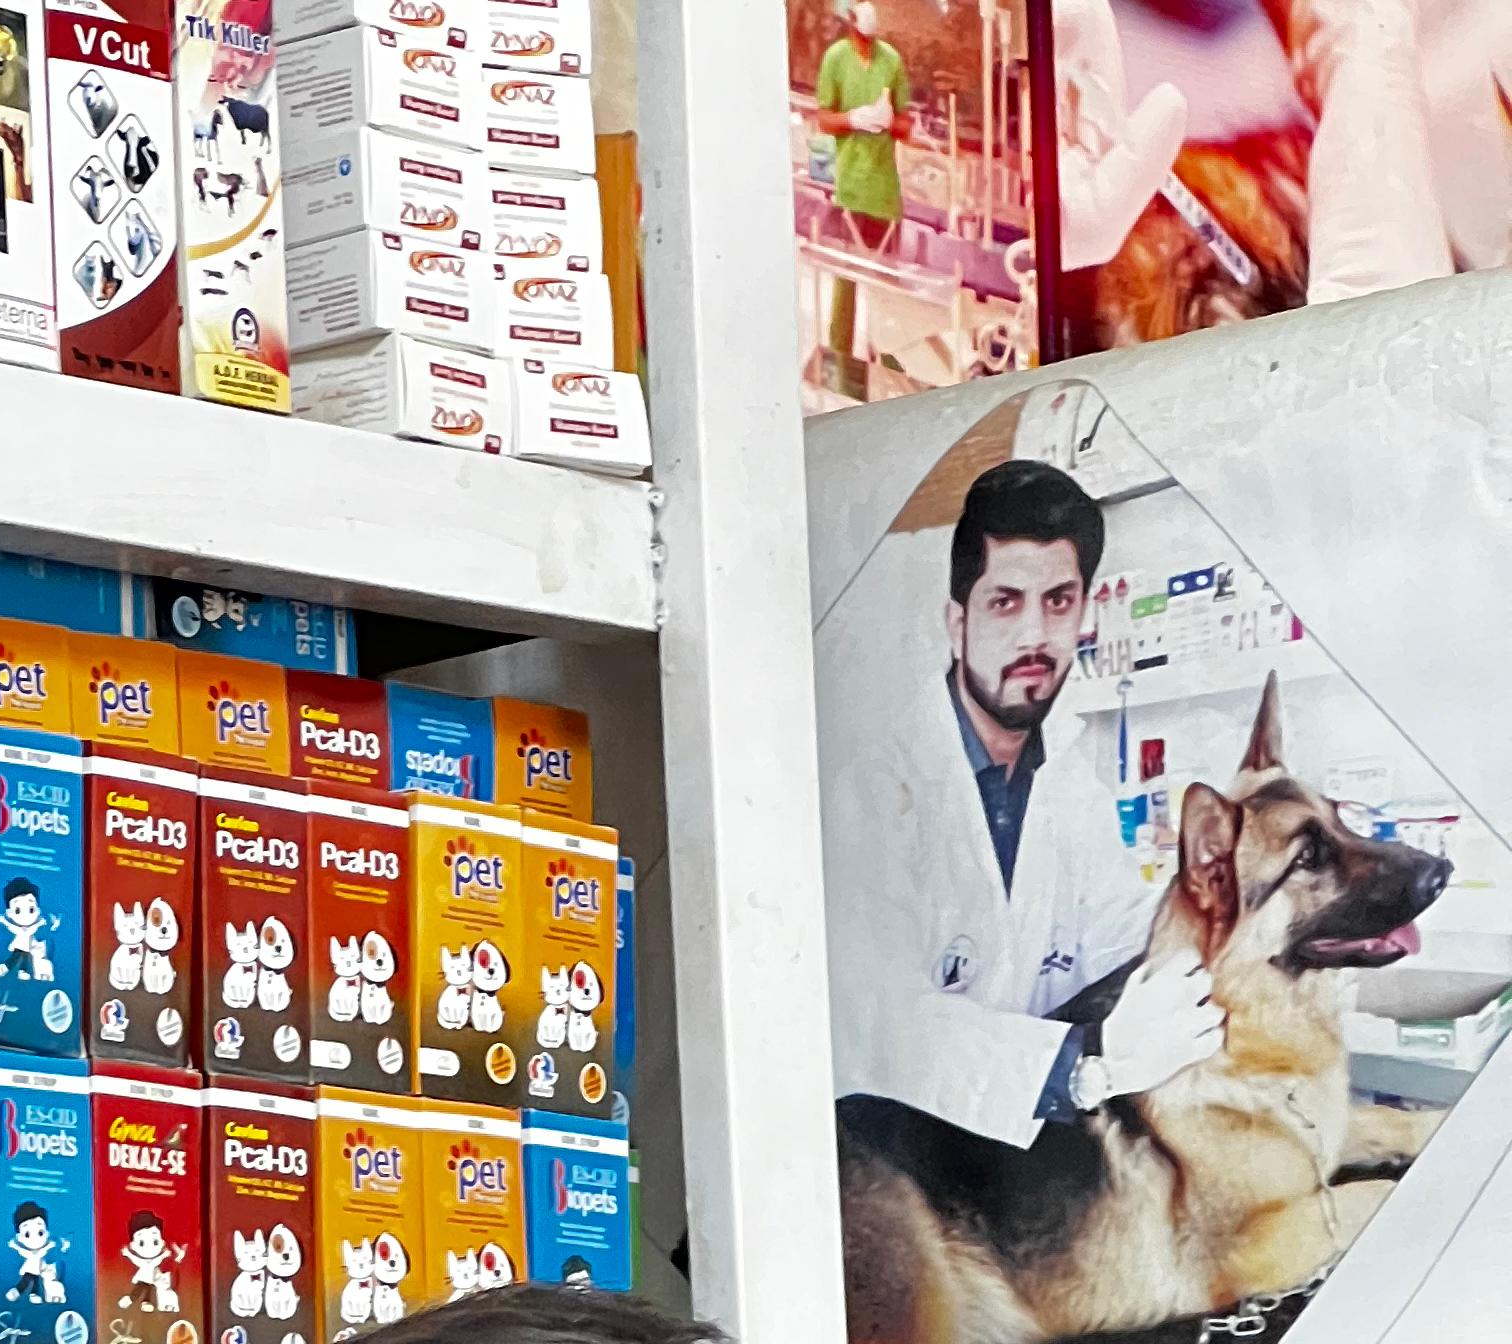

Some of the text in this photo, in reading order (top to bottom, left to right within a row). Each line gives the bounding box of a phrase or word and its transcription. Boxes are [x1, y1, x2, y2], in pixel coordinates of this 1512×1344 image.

[187, 16, 216, 43] Tik
[97, 679, 153, 728] pet
[216, 698, 272, 747] pet
[299, 721, 381, 760] Pcal-D3
[524, 744, 574, 789] pet
[105, 809, 187, 850] Pcal-D3
[216, 830, 299, 869] Pcal-D3
[320, 841, 400, 880] Pcal-D3
[452, 853, 505, 899] pet
[552, 874, 602, 921] pet
[224, 1139, 308, 1177] Pcal-D3
[352, 1144, 404, 1192] pet
[456, 1156, 509, 1202] pet
